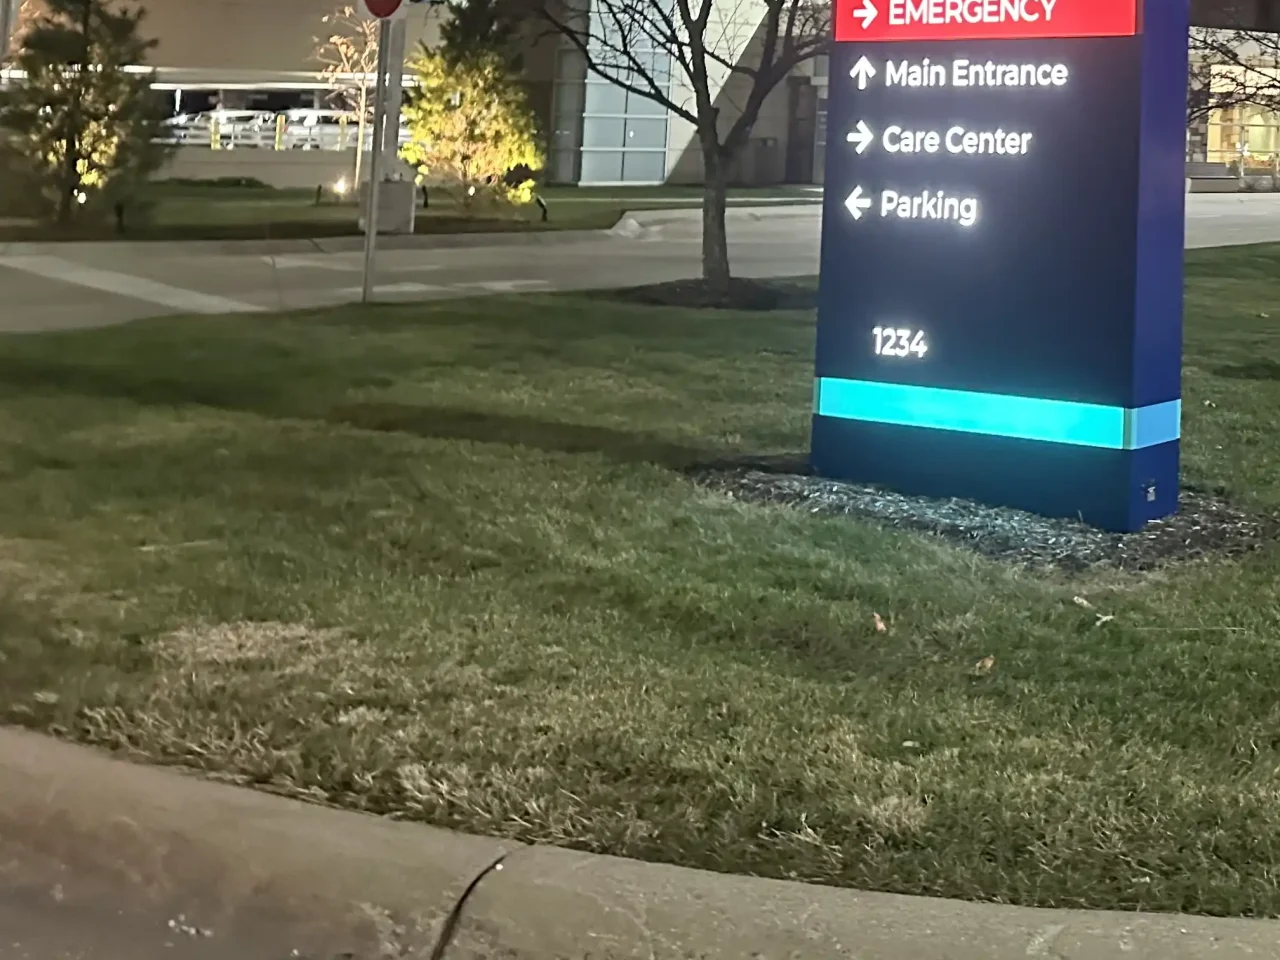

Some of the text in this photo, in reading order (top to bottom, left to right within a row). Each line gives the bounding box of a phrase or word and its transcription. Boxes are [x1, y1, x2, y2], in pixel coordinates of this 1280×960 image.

[885, 58, 1069, 88] Main Entrance
[883, 126, 1033, 156] Care Center
[880, 189, 978, 227] Parking
[872, 326, 928, 359] 1234
